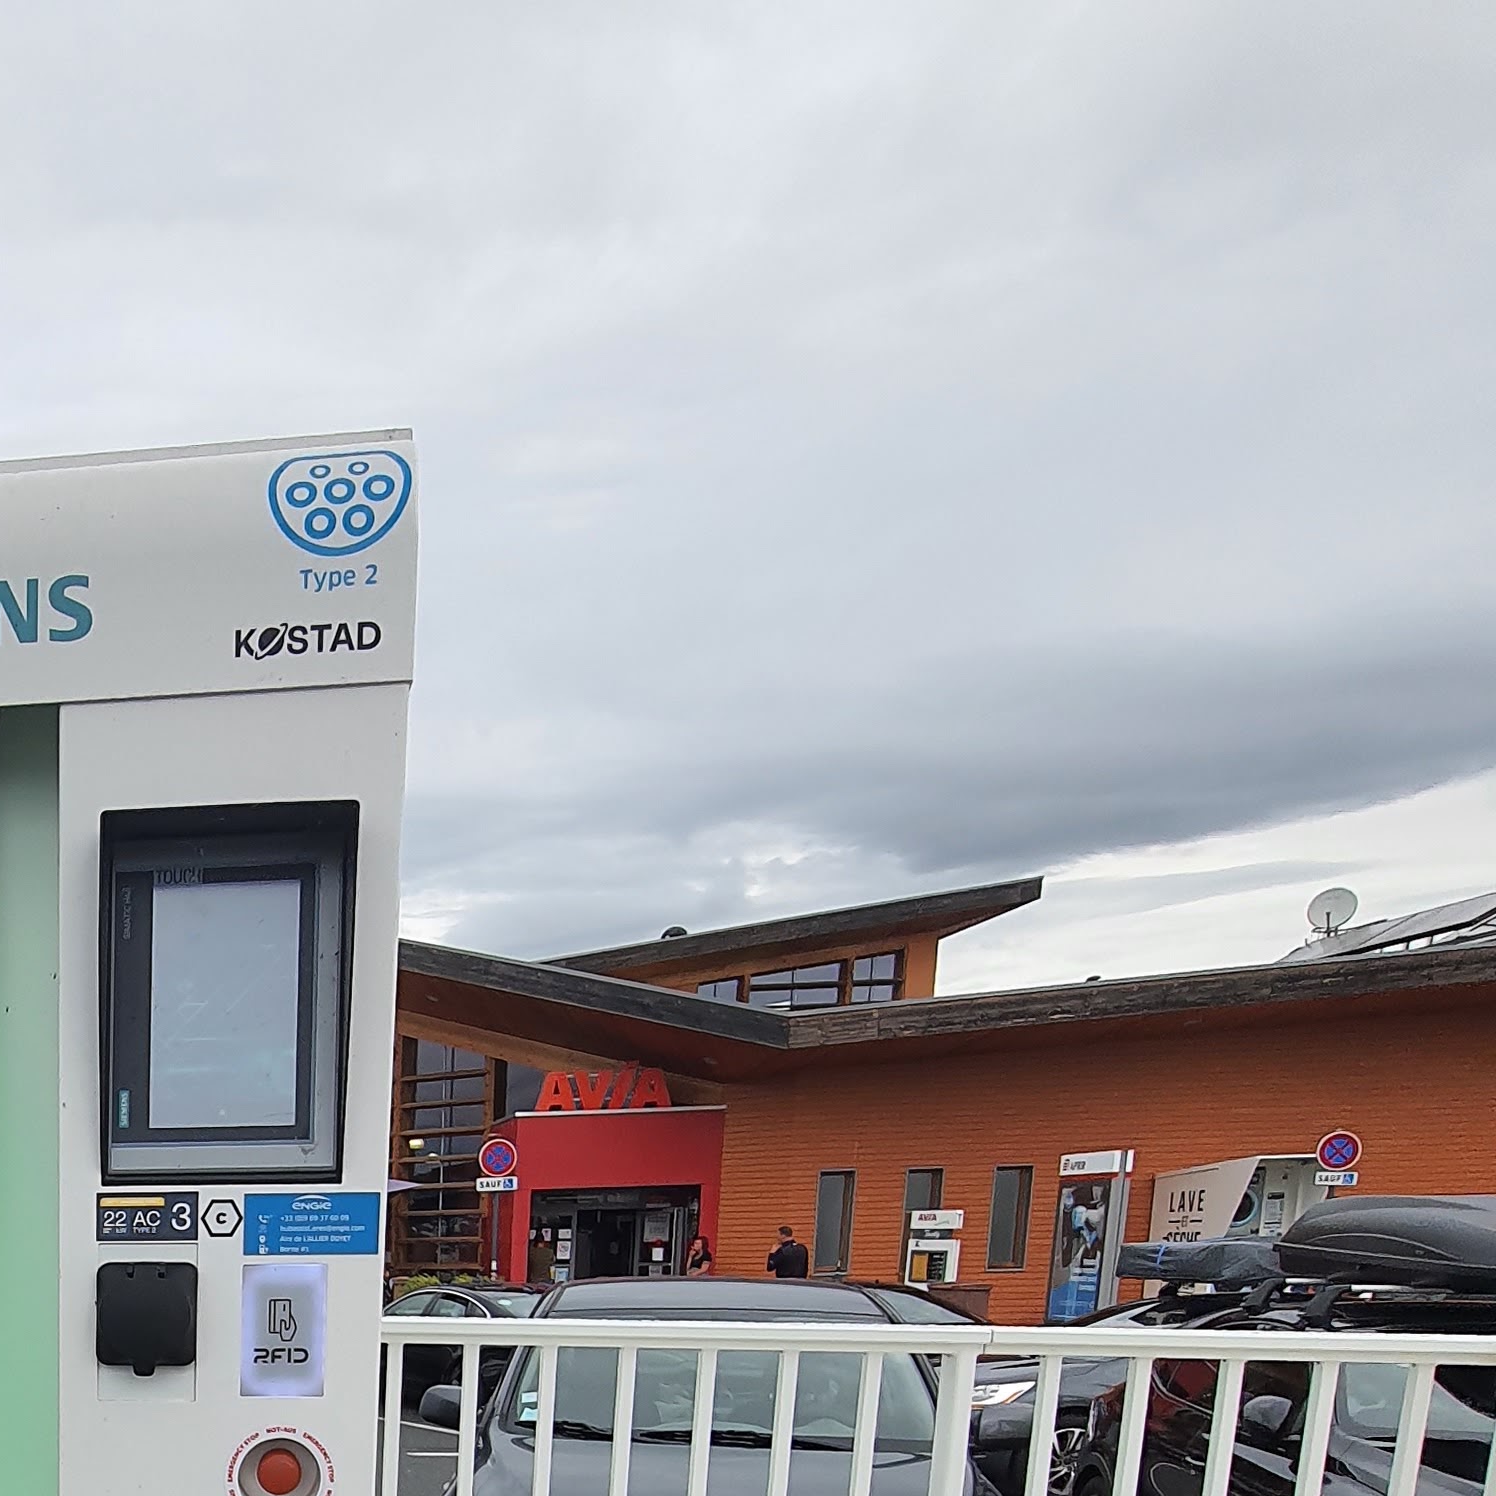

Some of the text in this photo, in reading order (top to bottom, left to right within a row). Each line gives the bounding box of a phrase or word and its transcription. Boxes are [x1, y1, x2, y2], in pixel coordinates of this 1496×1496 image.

[299, 564, 379, 593] Type 2
[534, 1062, 672, 1111] AVIA
[479, 1180, 502, 1189] SAUF
[1168, 1188, 1206, 1213] LAVE
[103, 1202, 192, 1231] 22 AC 3
[215, 1212, 227, 1224] C
[252, 1348, 310, 1364] RFID
